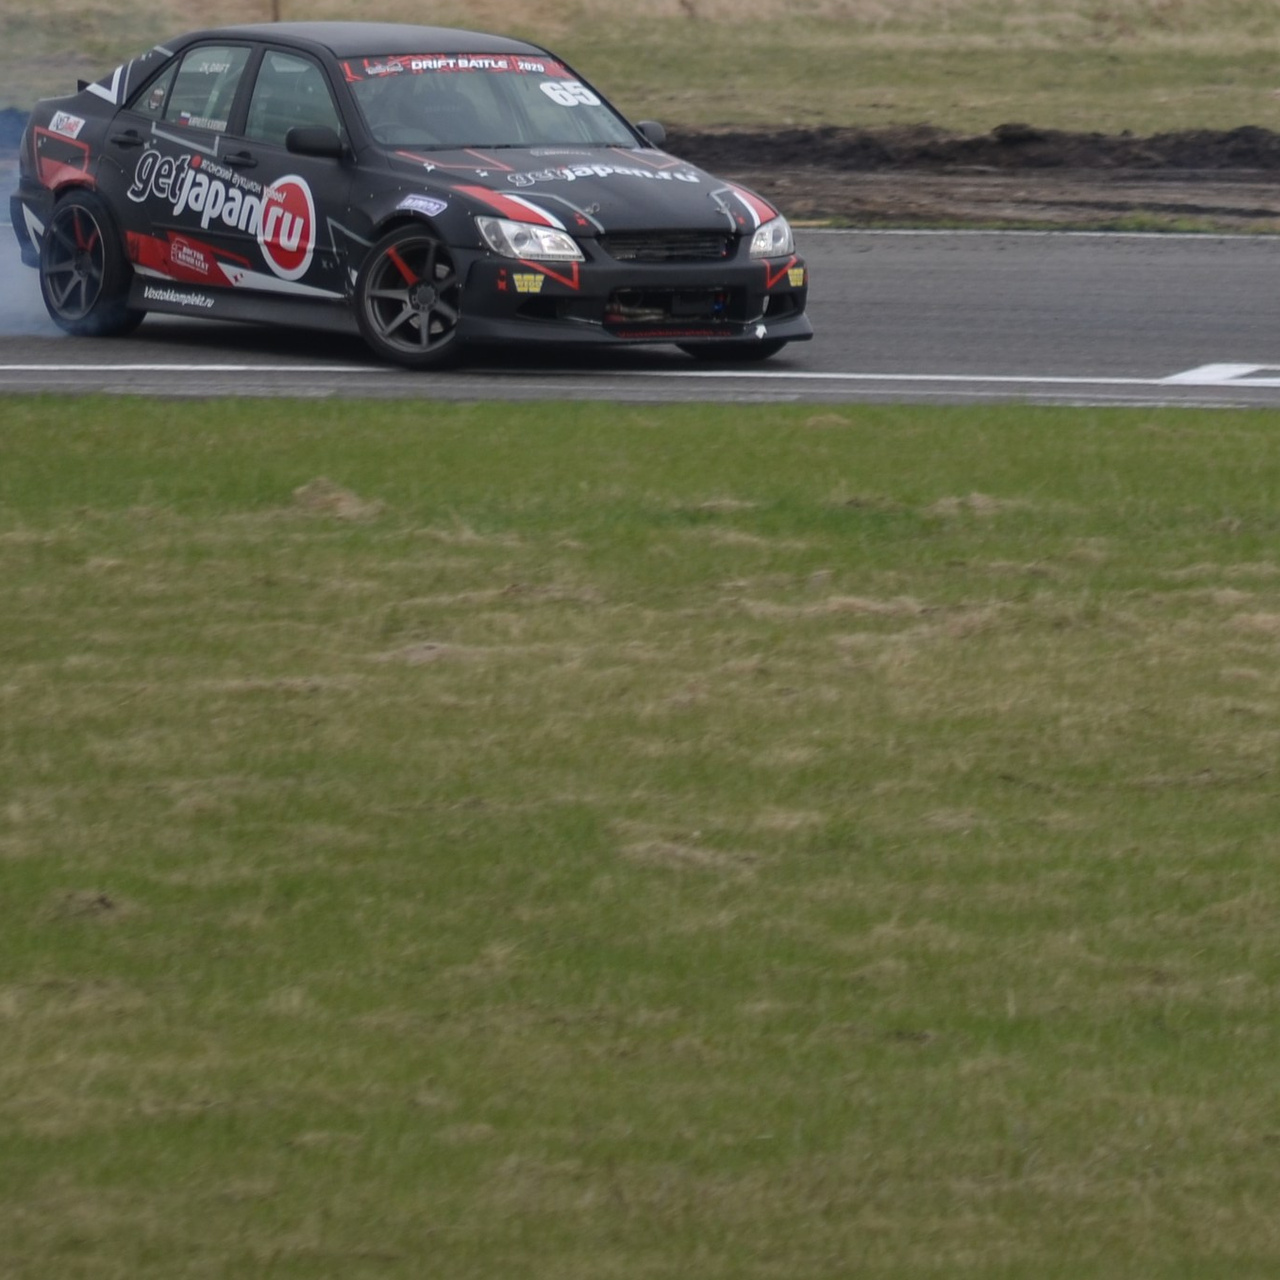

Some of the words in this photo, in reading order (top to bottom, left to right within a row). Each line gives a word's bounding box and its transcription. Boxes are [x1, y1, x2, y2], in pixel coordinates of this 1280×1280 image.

[411, 59, 456, 70] DRIFT
[458, 59, 508, 69] BATTLE
[539, 81, 601, 107] 65
